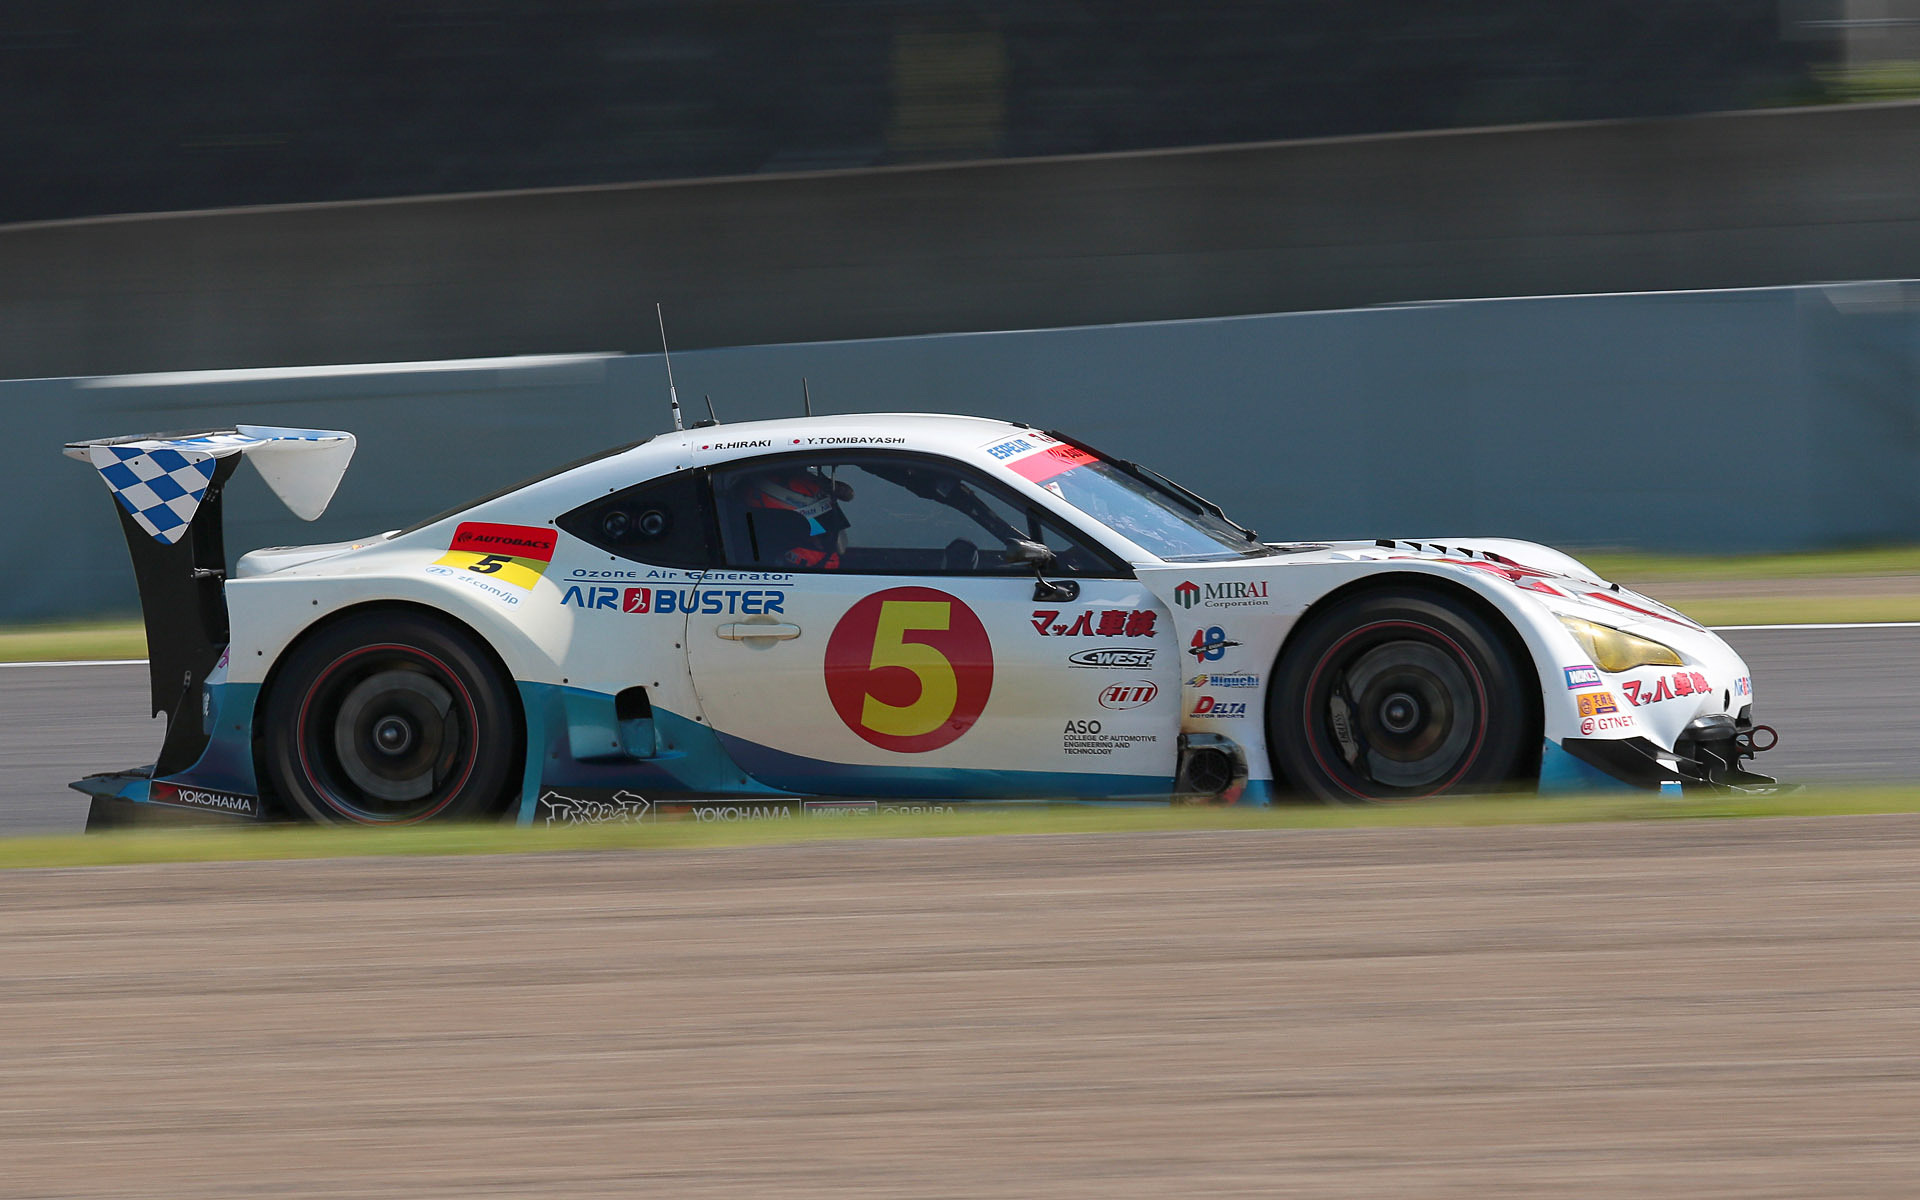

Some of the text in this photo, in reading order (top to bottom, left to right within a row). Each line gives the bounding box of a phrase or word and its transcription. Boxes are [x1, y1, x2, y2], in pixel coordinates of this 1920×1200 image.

[714, 439, 772, 449] R.HIRAKI
[807, 437, 906, 446] Y.TOMIBAYASHI
[474, 535, 551, 549] AUTOBACS
[468, 554, 513, 574] 5
[572, 568, 794, 581] Ozone Air Generator
[457, 575, 519, 605] zf.com/jp
[1203, 581, 1269, 599] MIRAI
[560, 585, 786, 615] AIR BUSTER
[1204, 599, 1269, 609] Corporation
[1031, 609, 1158, 637] マッハ車検
[860, 600, 958, 736] 5
[1210, 675, 1260, 688] Higuchi
[1063, 719, 1102, 735] ASO
[1598, 715, 1634, 730] GTNET
[1063, 734, 1097, 742] COLLEGE
[1098, 734, 1110, 742] OF
[177, 788, 251, 812] YOKOHAMA
[692, 806, 792, 824] YOKOHAMA
